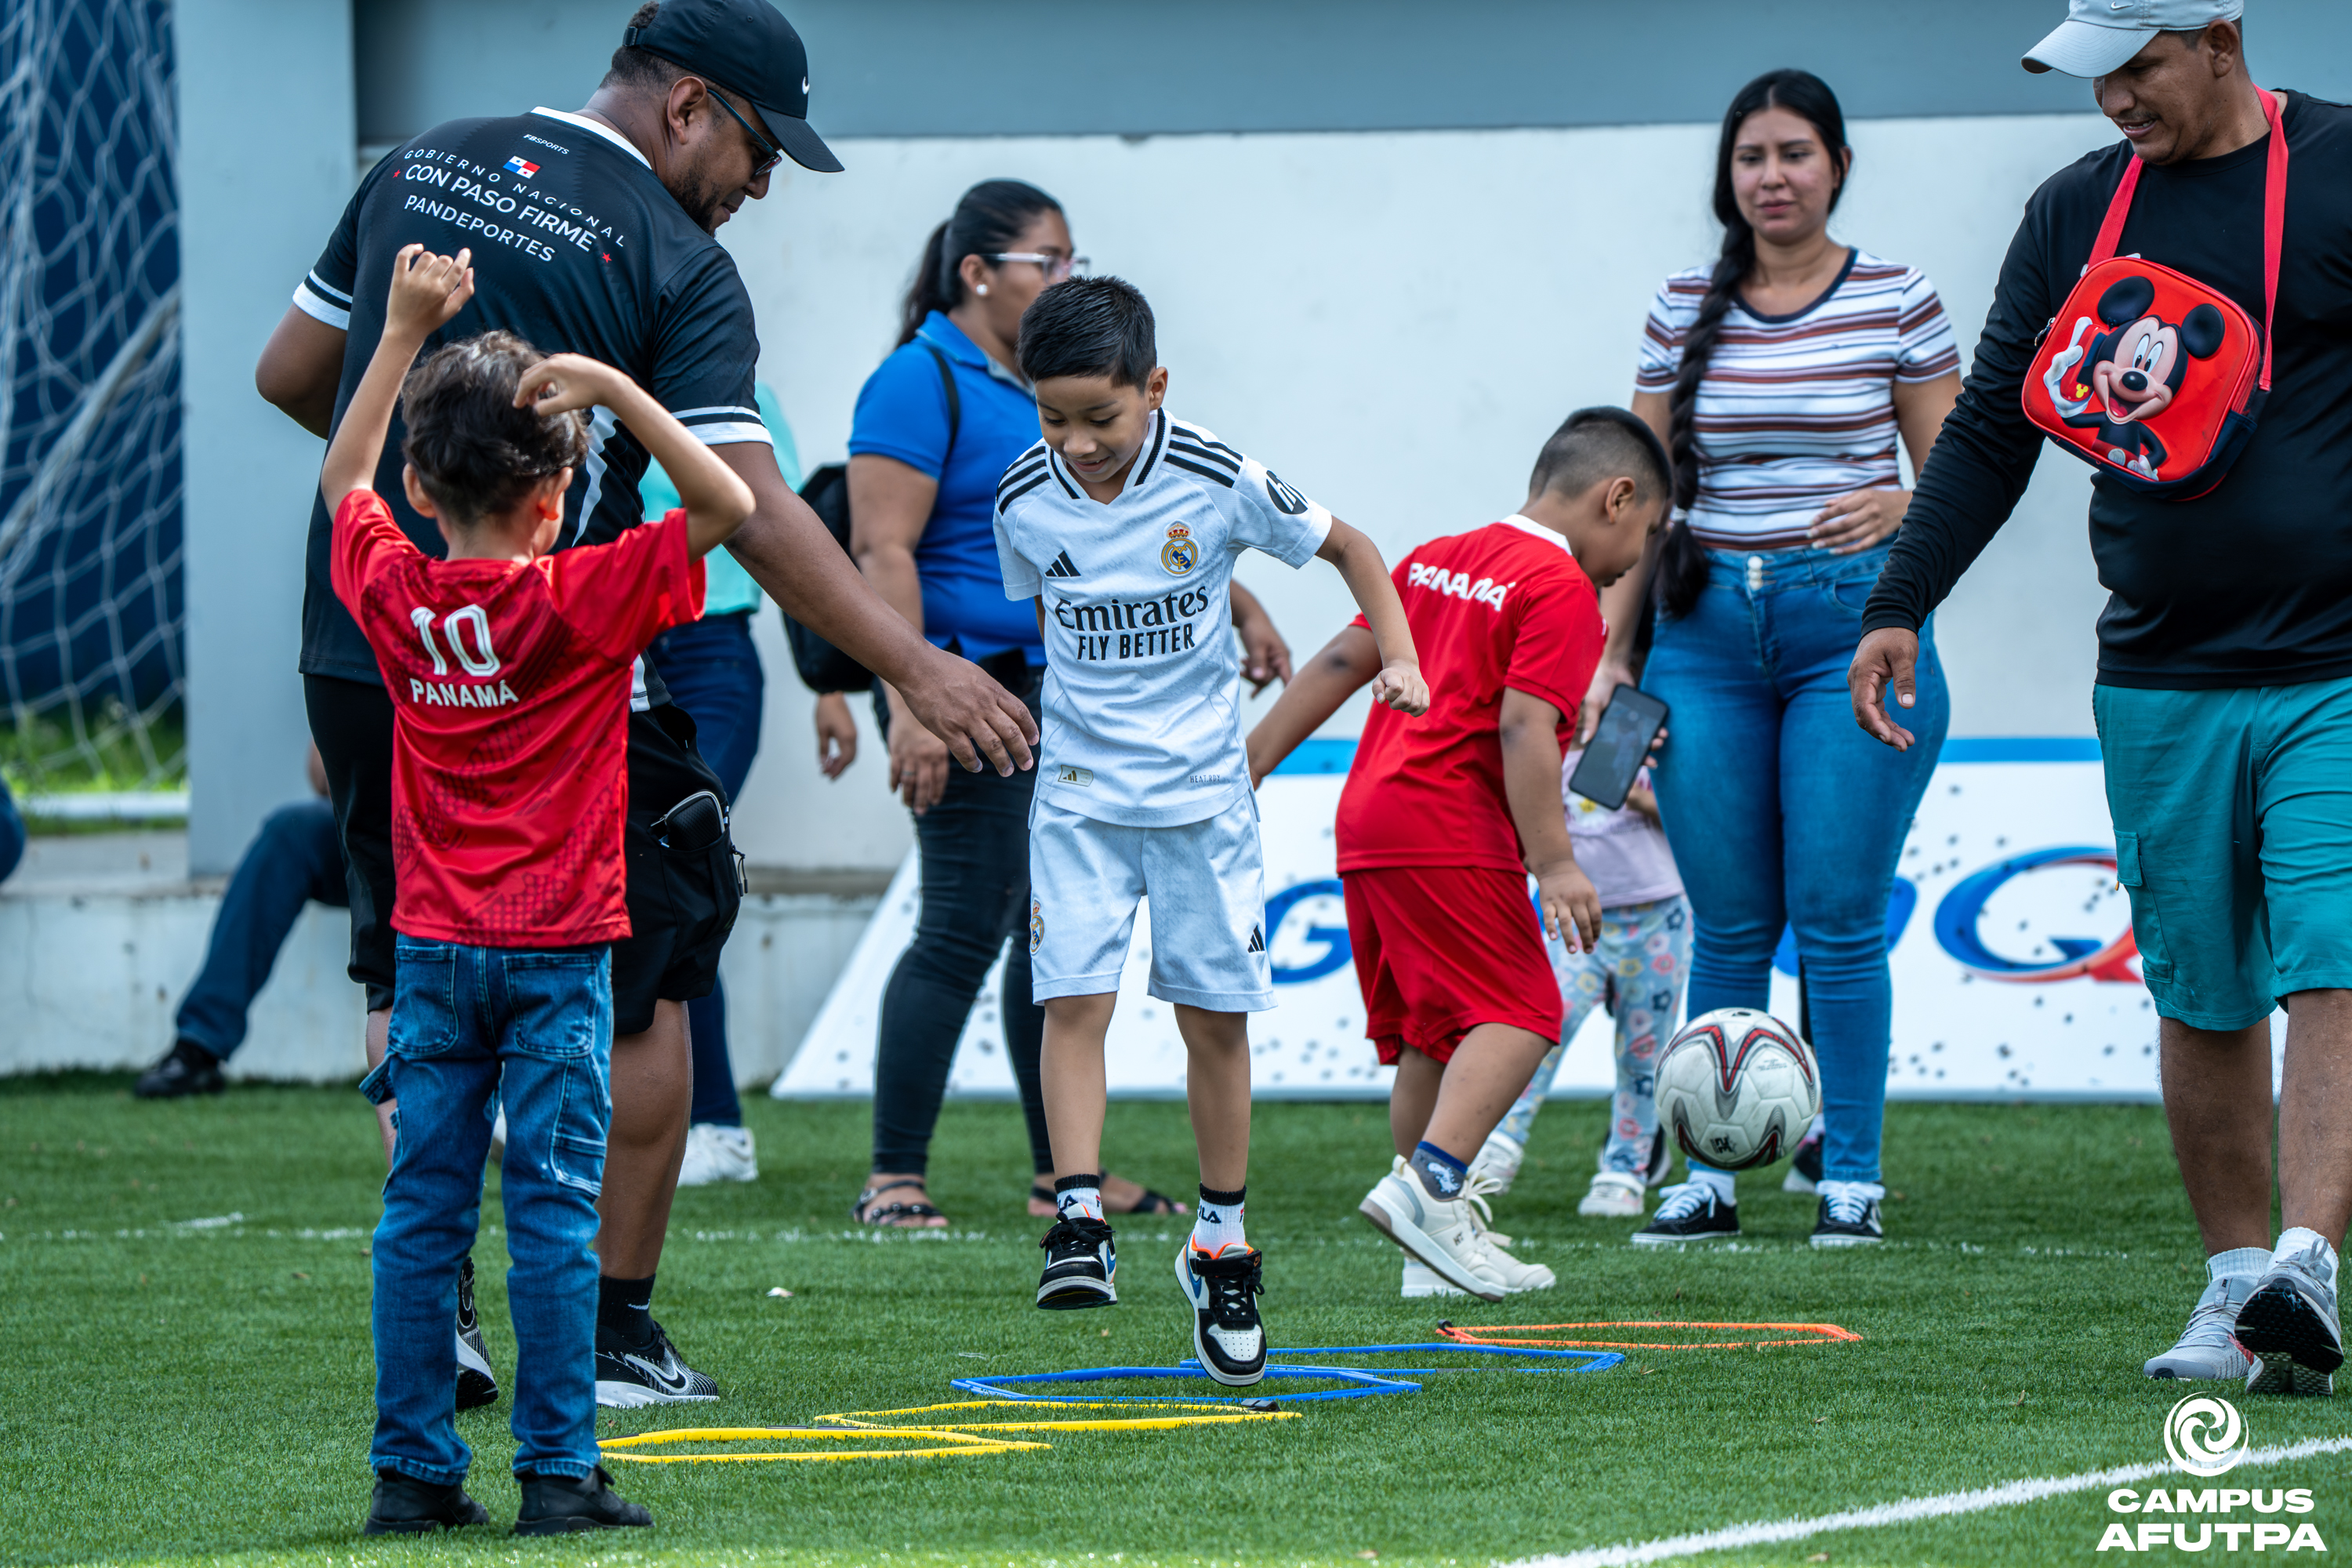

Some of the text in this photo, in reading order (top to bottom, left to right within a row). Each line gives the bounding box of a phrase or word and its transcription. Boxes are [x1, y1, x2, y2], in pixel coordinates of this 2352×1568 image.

[522, 133, 570, 154] FBSPORTS
[404, 148, 625, 247] GOBIERNO NACIONAL
[405, 163, 597, 252] CON PASO FIRME
[404, 194, 556, 262] PANDEPORTES
[1054, 586, 1209, 632] Emirates
[410, 603, 501, 677] 10
[1077, 622, 1196, 661] FLY BETTER
[1199, 1205, 1221, 1224] ILA
